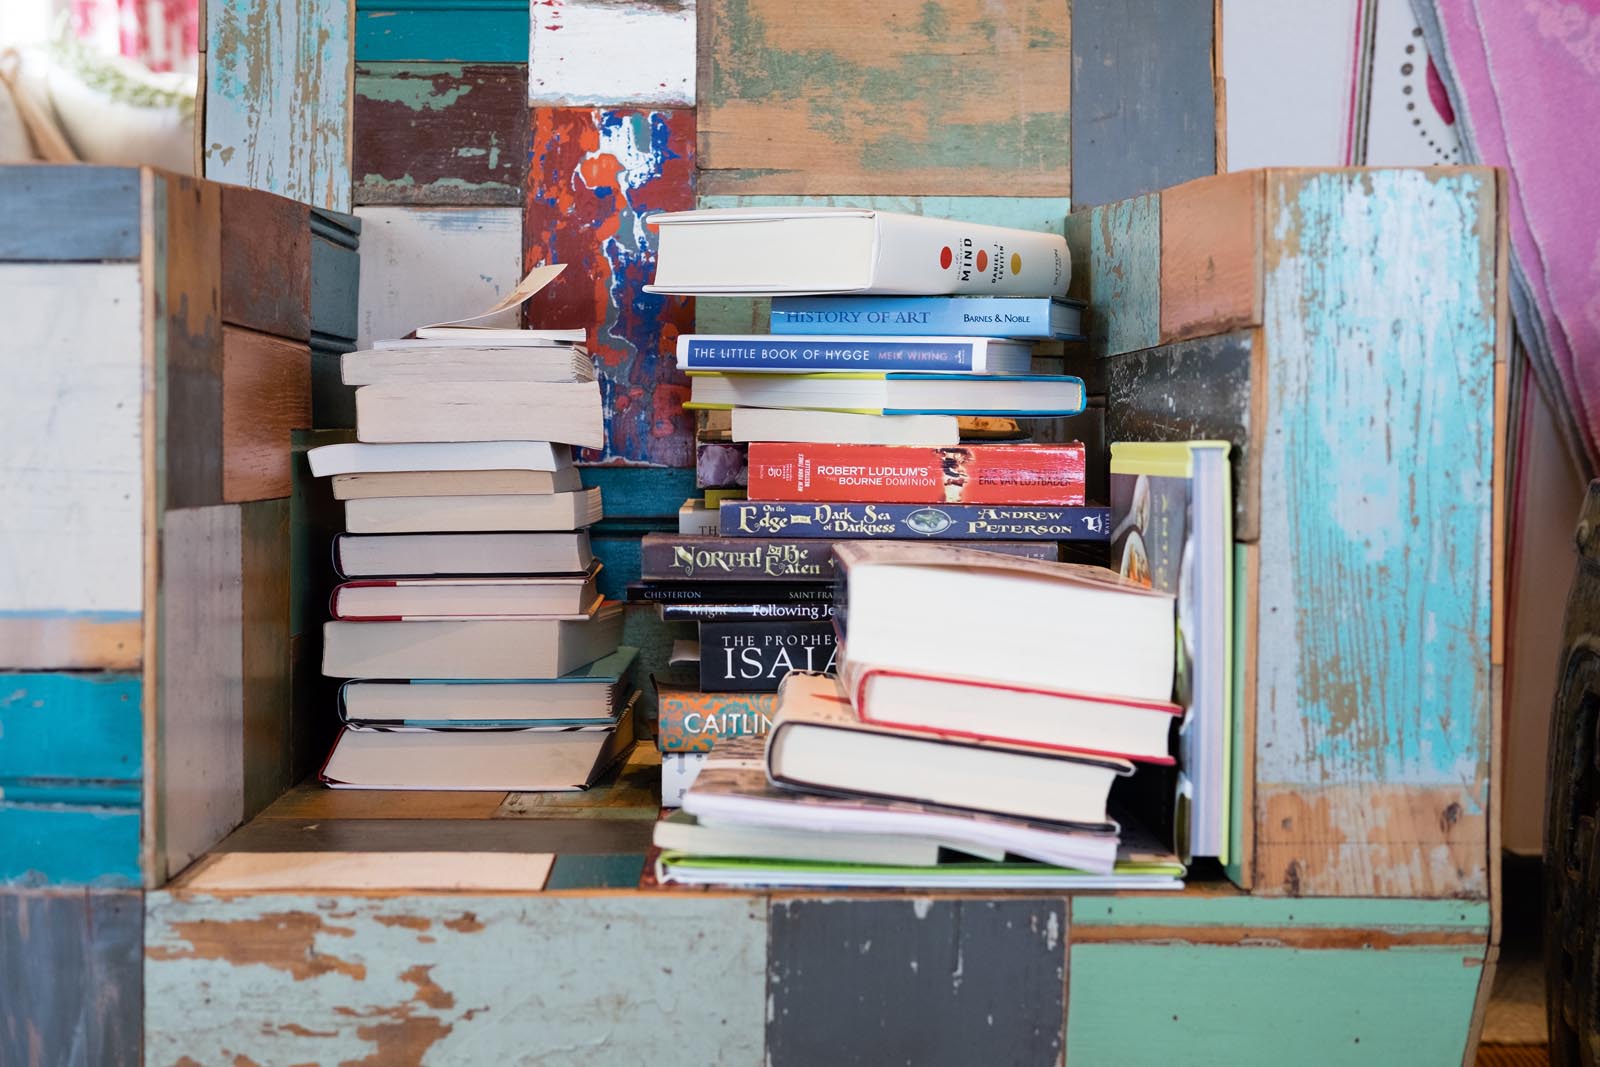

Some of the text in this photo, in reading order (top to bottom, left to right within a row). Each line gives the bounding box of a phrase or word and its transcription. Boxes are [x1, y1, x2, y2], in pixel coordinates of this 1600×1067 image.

[961, 238, 973, 282] MIND
[991, 253, 999, 284] DANIEL
[786, 311, 929, 324] HISTORY OF ART
[963, 314, 1031, 323] BARNES & NOBLE
[694, 348, 716, 359] THE
[720, 348, 757, 360] LITTLE
[762, 348, 798, 360] BOOK
[802, 348, 822, 361] OF
[825, 348, 870, 361] HYGGE
[878, 351, 903, 361] MEIK
[907, 351, 948, 362] WIKING
[797, 453, 805, 492] NEW YORK TIMES
[817, 466, 928, 478] ROBERT LUDLUM'S
[838, 477, 883, 487] BOURNE
[885, 478, 936, 487] DOMINION
[978, 475, 998, 486] ERIC
[1000, 475, 1018, 486] VAN
[762, 505, 787, 513] On the
[814, 504, 891, 524] Dark Sea
[977, 508, 1063, 521] ANDREW
[737, 506, 788, 533] Edge
[823, 520, 896, 536] of Darkness
[967, 520, 1073, 536] PETERSON
[668, 545, 762, 576] NORTH!
[782, 544, 809, 564] Be
[763, 556, 821, 576] Eaten
[644, 591, 702, 599] CHESTERTON
[789, 591, 815, 599] SAINT
[689, 604, 728, 619] Wright
[752, 604, 820, 620] Following
[721, 635, 755, 647] THE
[684, 713, 774, 735] CAITLIN
